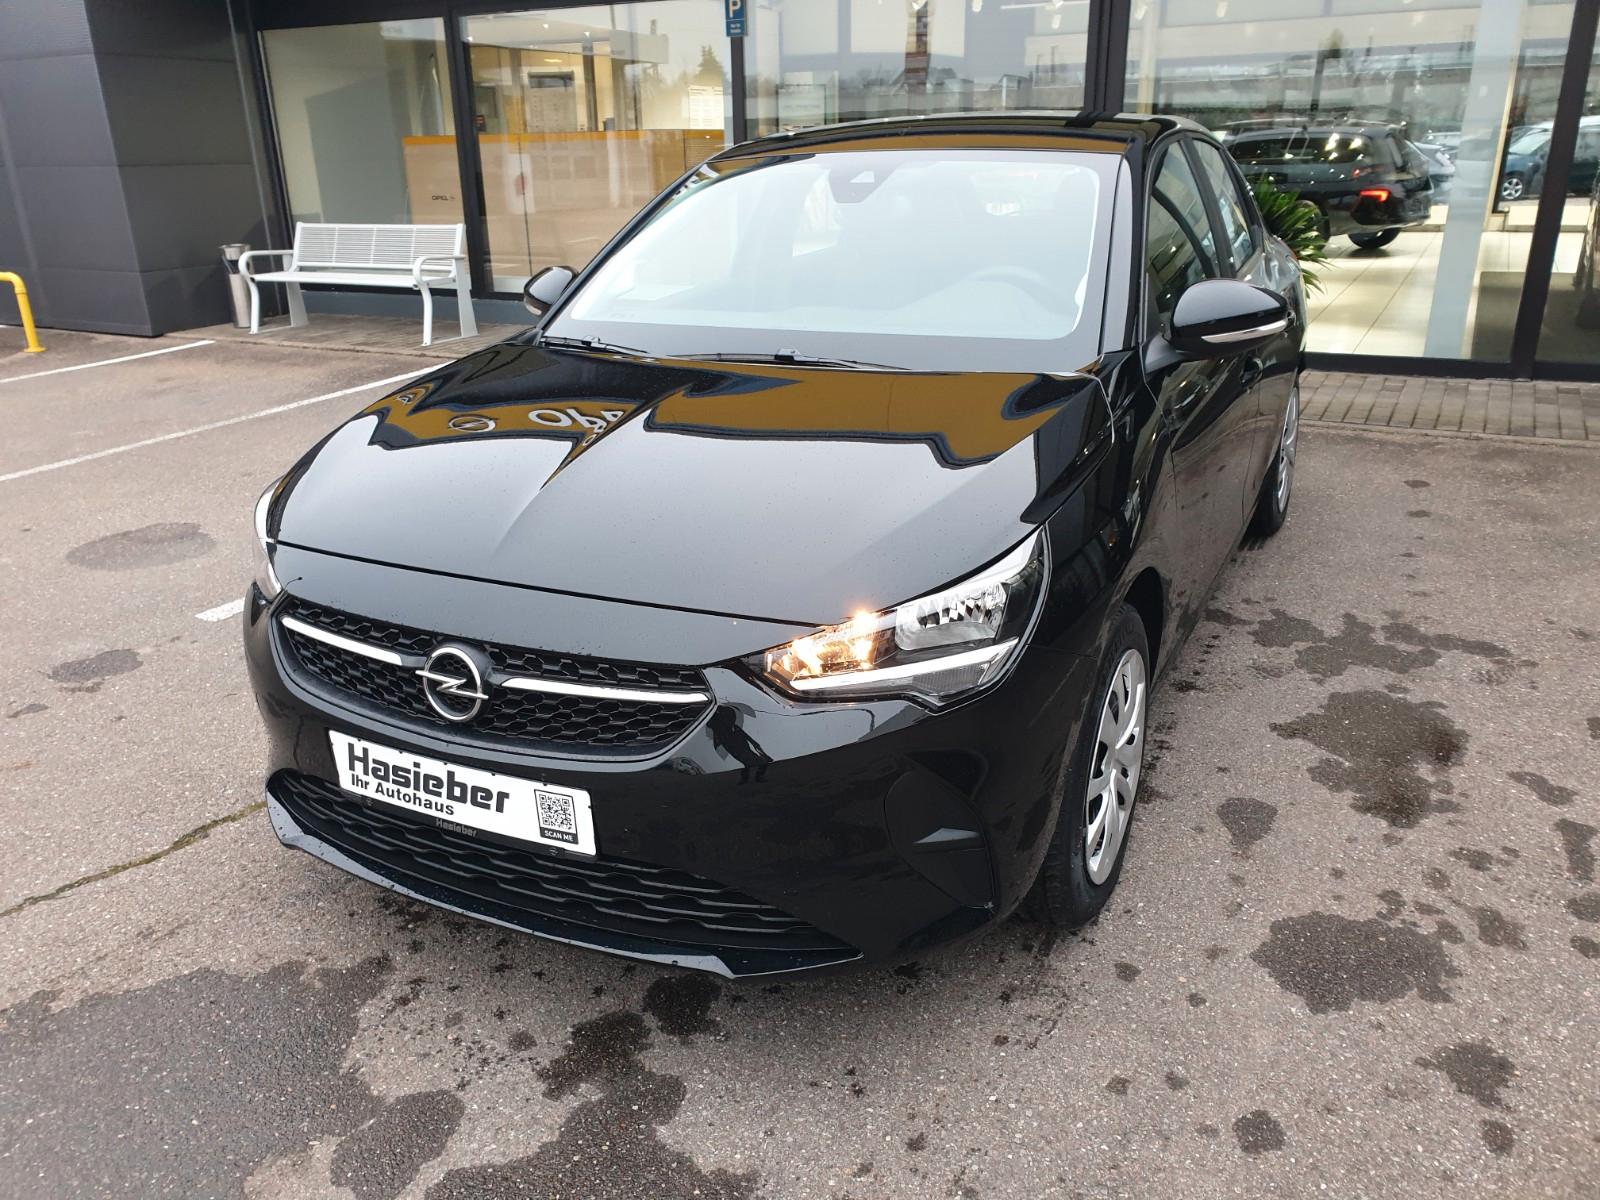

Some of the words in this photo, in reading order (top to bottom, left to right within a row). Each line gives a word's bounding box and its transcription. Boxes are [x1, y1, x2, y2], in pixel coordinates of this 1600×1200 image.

[729, 0, 741, 18] P
[347, 742, 510, 814] Hasieber
[351, 773, 370, 790] Ihr
[375, 782, 455, 816] Autohaus
[544, 830, 563, 840] SCAN
[563, 833, 574, 842] ME
